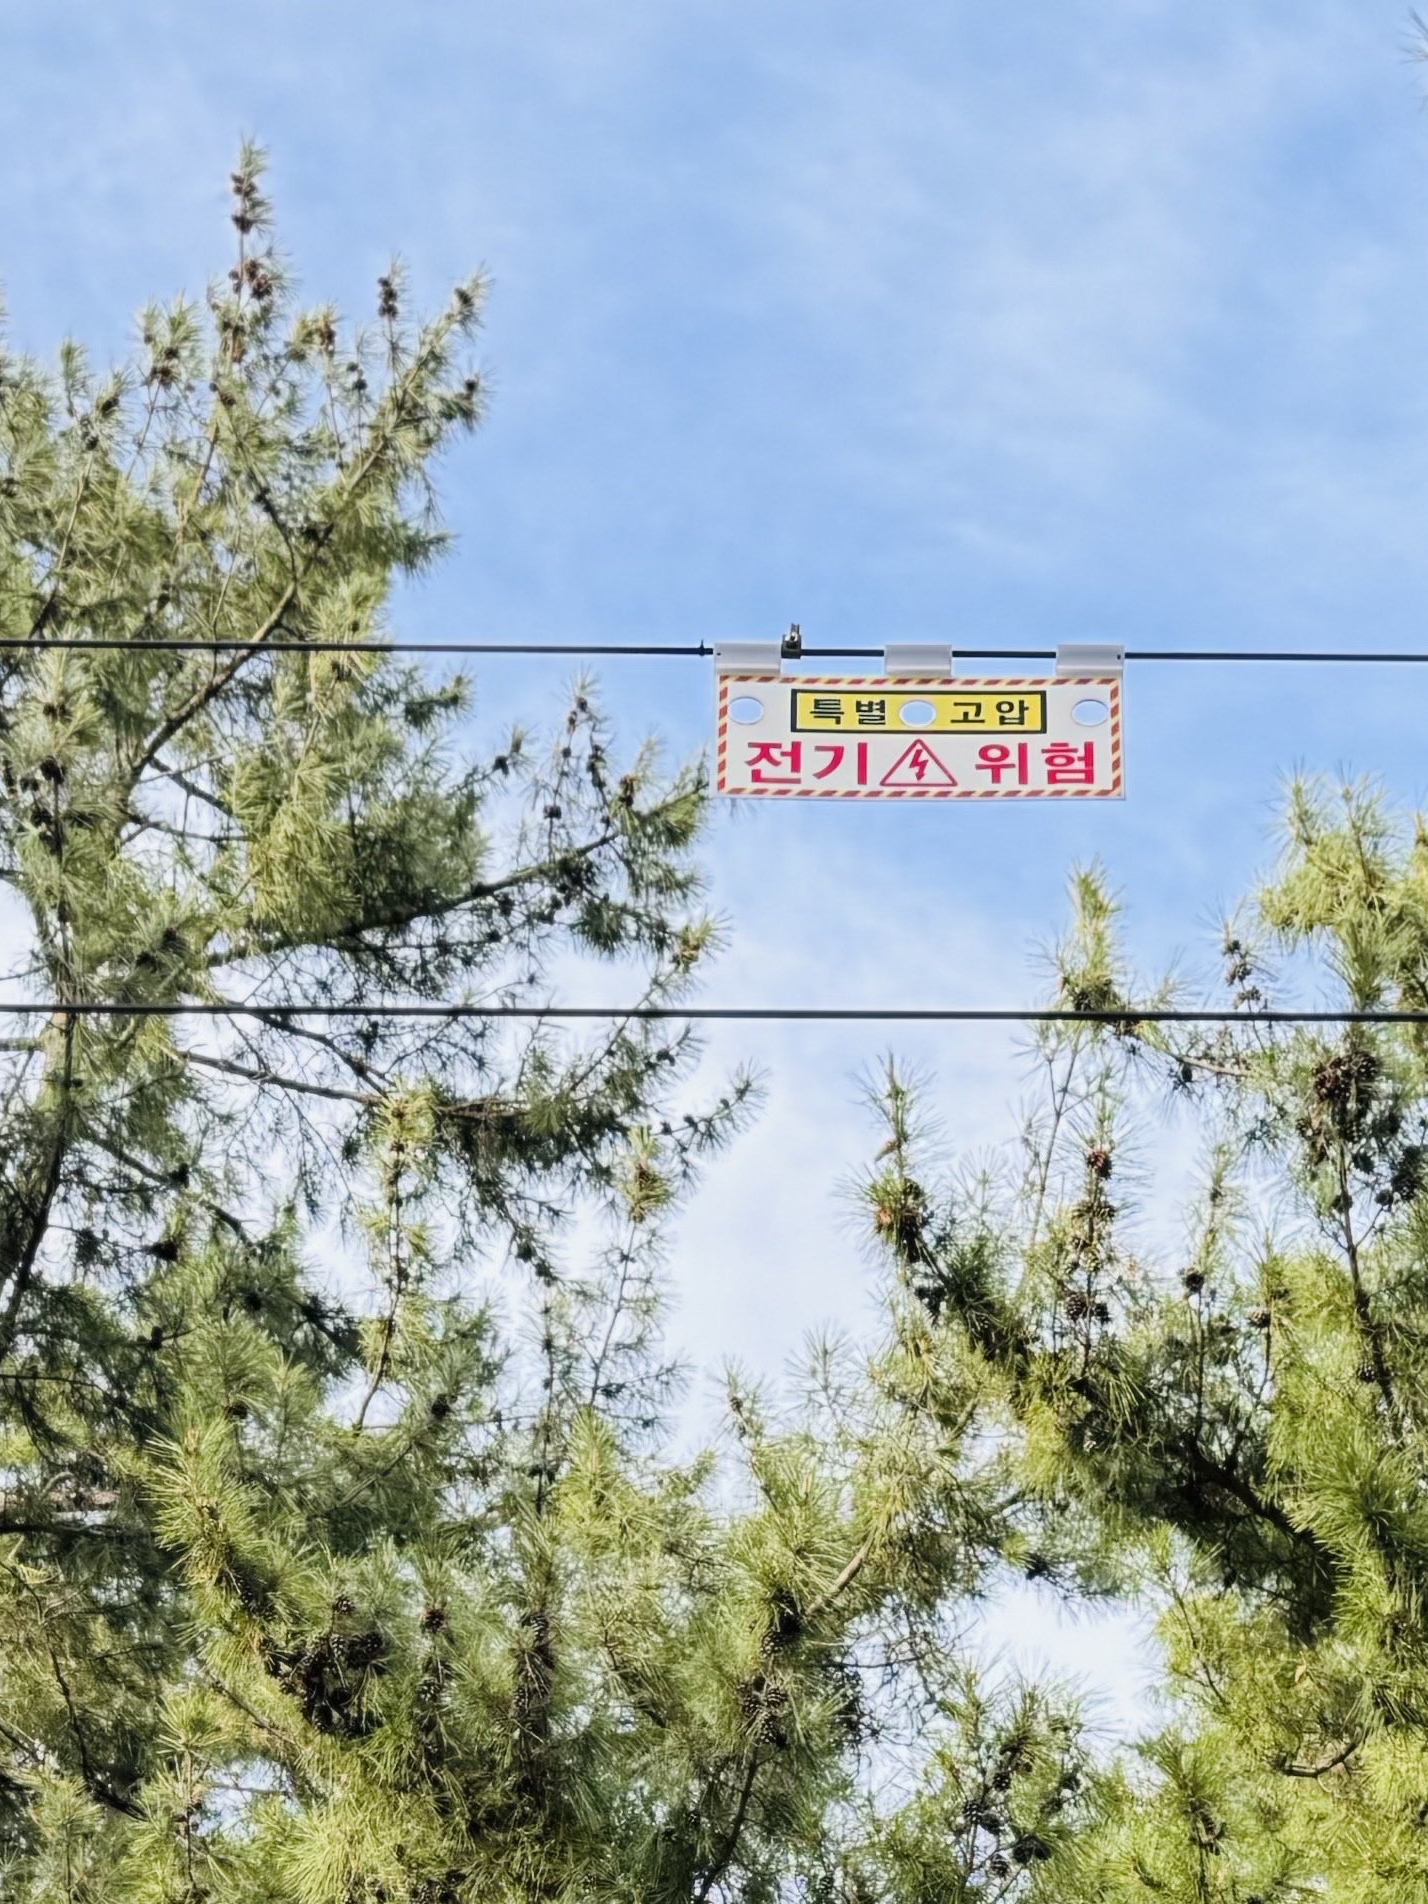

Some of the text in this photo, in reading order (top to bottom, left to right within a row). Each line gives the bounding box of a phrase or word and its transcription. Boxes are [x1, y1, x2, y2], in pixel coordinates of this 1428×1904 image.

[809, 698, 1030, 726] 특별 고압
[744, 740, 1095, 786] 전기 위험
